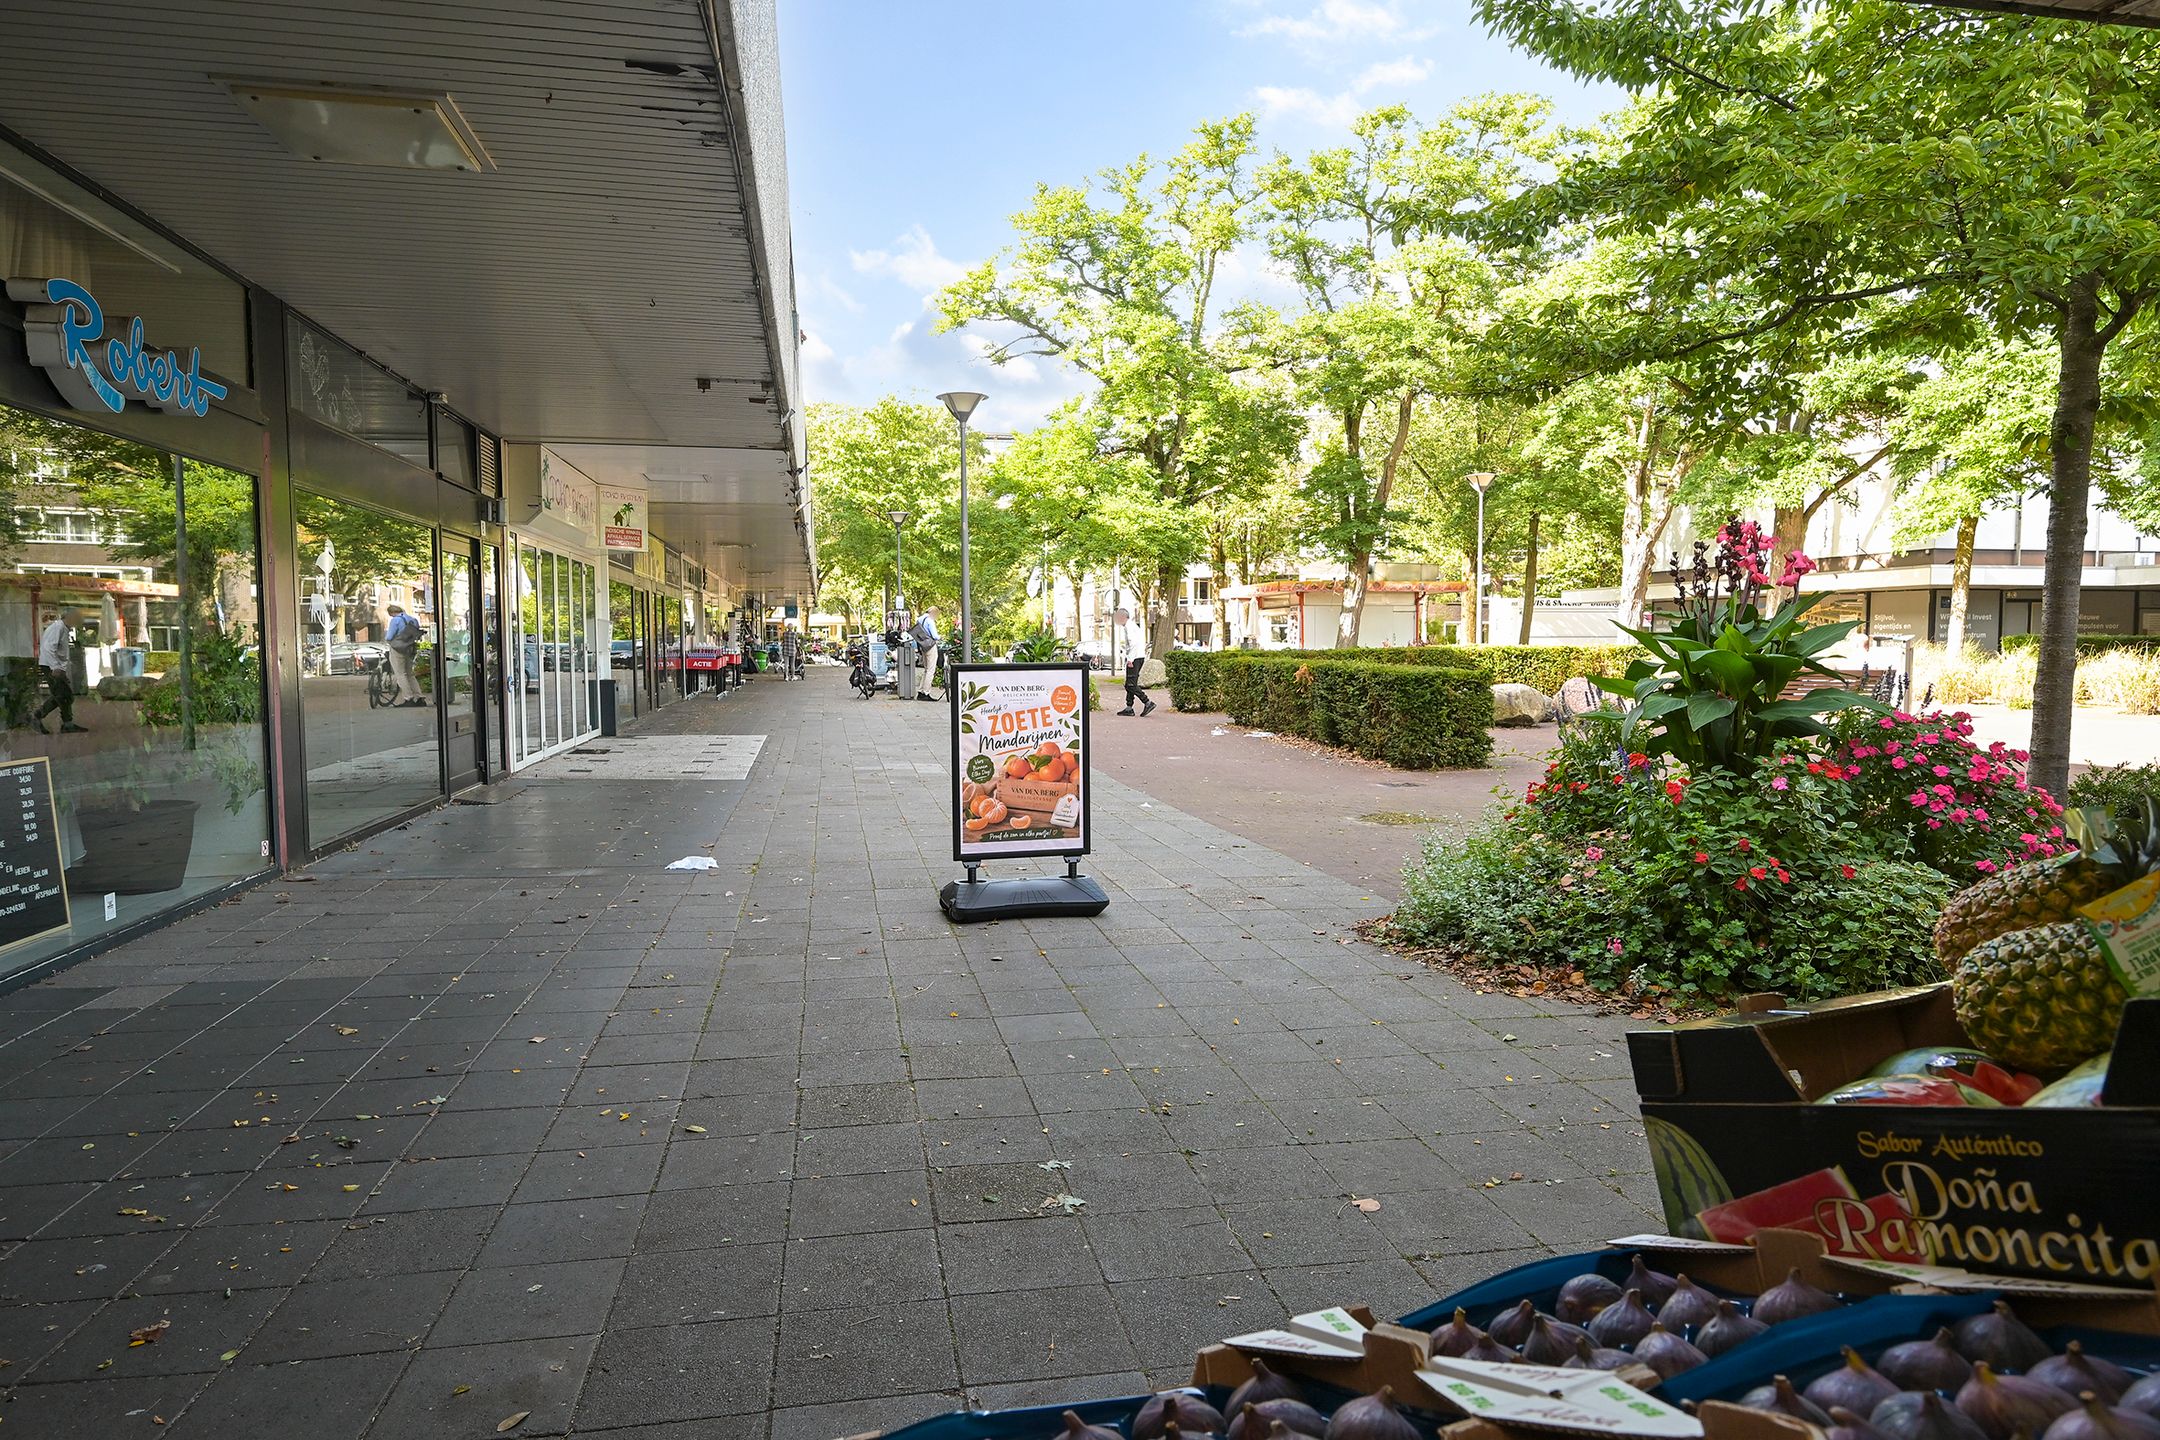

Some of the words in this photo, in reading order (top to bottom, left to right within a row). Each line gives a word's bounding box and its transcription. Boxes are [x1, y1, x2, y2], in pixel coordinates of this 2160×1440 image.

[47, 278, 227, 417] Robert
[1874, 614, 1896, 622] Stijlvol,
[1972, 613, 1992, 621] Invest
[1873, 623, 1902, 631] eigentijds
[2077, 623, 2104, 631] mpulsen
[987, 705, 1054, 737] ZOETE
[978, 729, 1064, 754] Mandarijnen
[1025, 788, 1040, 796] DEN
[1040, 789, 1060, 797] BERG
[33, 868, 49, 878] SALON
[1856, 1131, 1923, 1158] Sabor
[1931, 1133, 2044, 1161] Auténtico
[1882, 1161, 2043, 1221] Doña
[1814, 1197, 2160, 1279] Ramoncita
